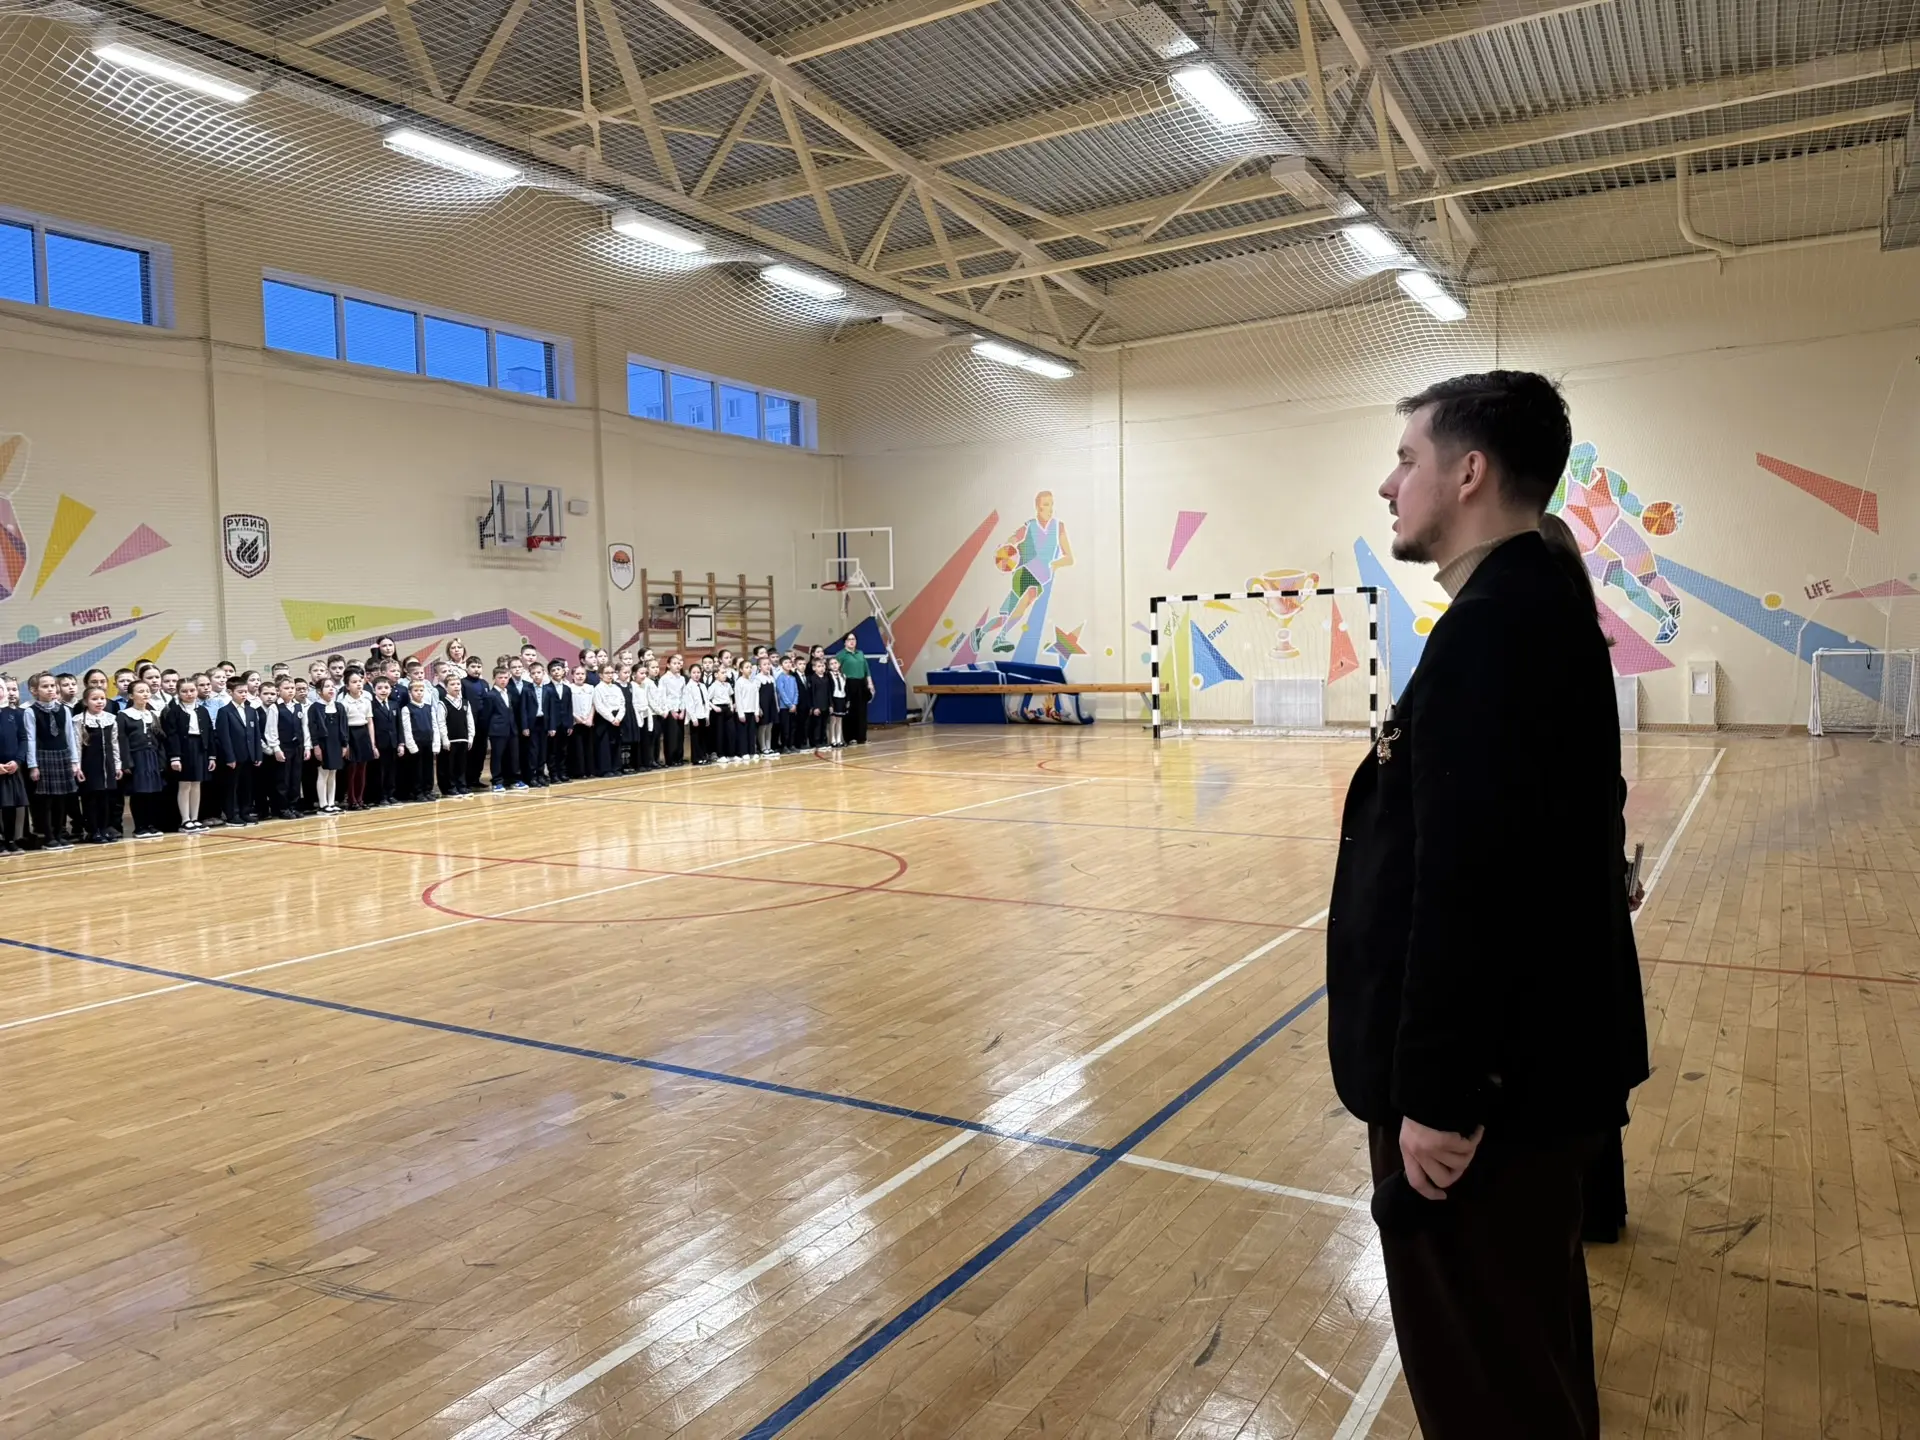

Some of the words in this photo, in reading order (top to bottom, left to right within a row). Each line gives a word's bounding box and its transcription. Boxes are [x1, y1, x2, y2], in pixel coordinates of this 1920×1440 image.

[227, 518, 265, 530] РУБИН
[1804, 579, 1833, 600] LIFE
[70, 606, 112, 626] POWER
[327, 615, 356, 631] СПОРТ
[1207, 619, 1229, 641] SPORT
